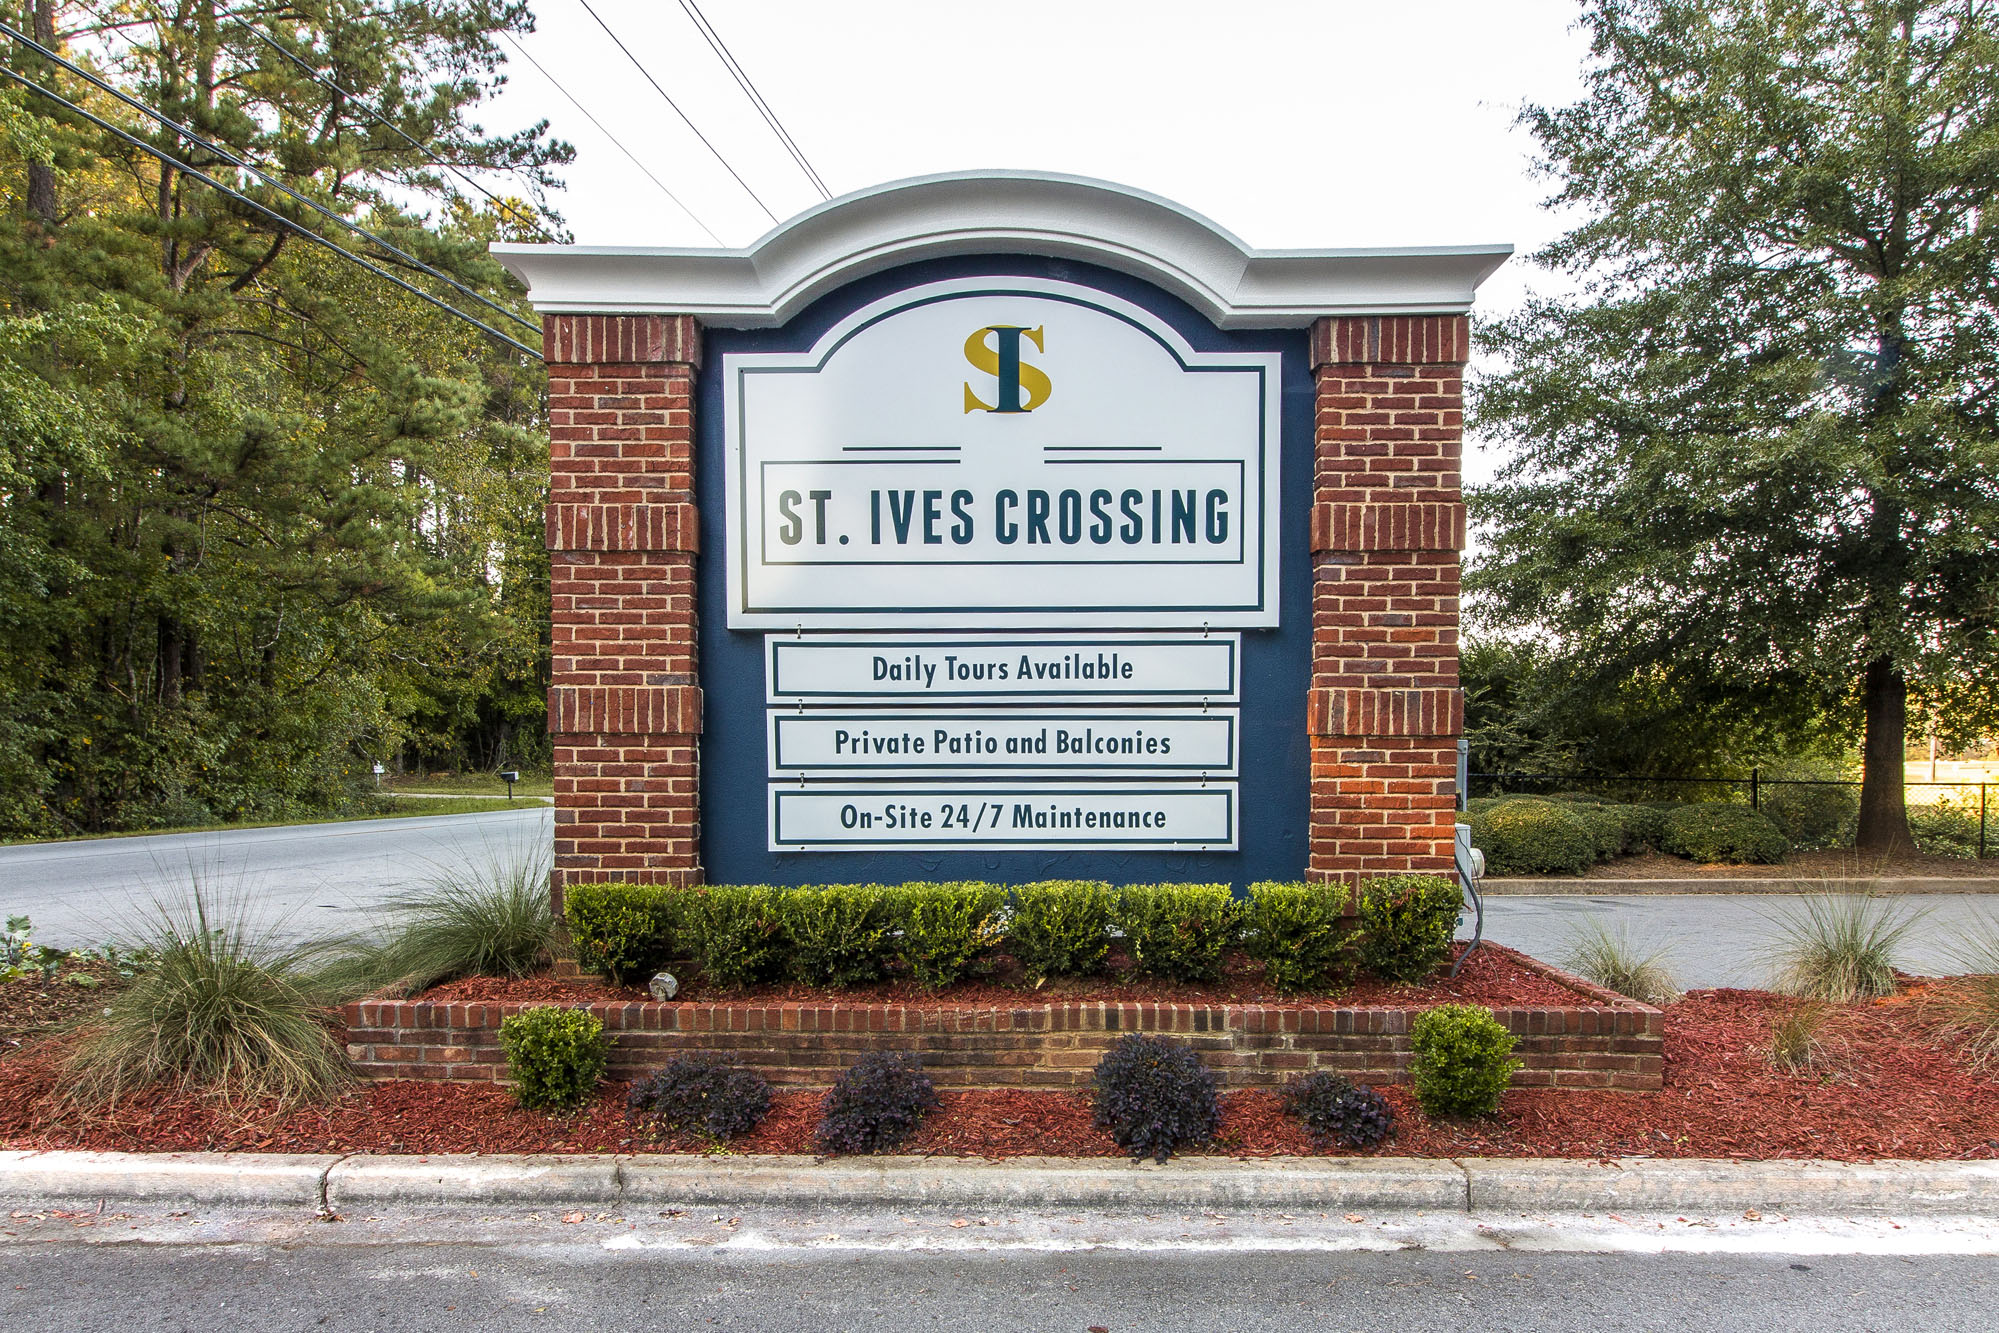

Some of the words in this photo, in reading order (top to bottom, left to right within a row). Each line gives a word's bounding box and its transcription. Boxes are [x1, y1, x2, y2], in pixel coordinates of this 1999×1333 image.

[779, 489, 850, 546] ST.
[870, 488, 974, 545] IVES
[995, 488, 1229, 545] CROSSING
[872, 655, 937, 689] Daily
[944, 655, 1009, 681] Tours
[1016, 652, 1134, 680] Available
[835, 729, 925, 755] Private
[933, 729, 998, 755] Patio
[1005, 727, 1047, 755] and
[1056, 727, 1171, 755] Balconies
[840, 803, 933, 829] On-Site
[940, 801, 1004, 834] 24/7
[1011, 803, 1167, 829] Maintenance
